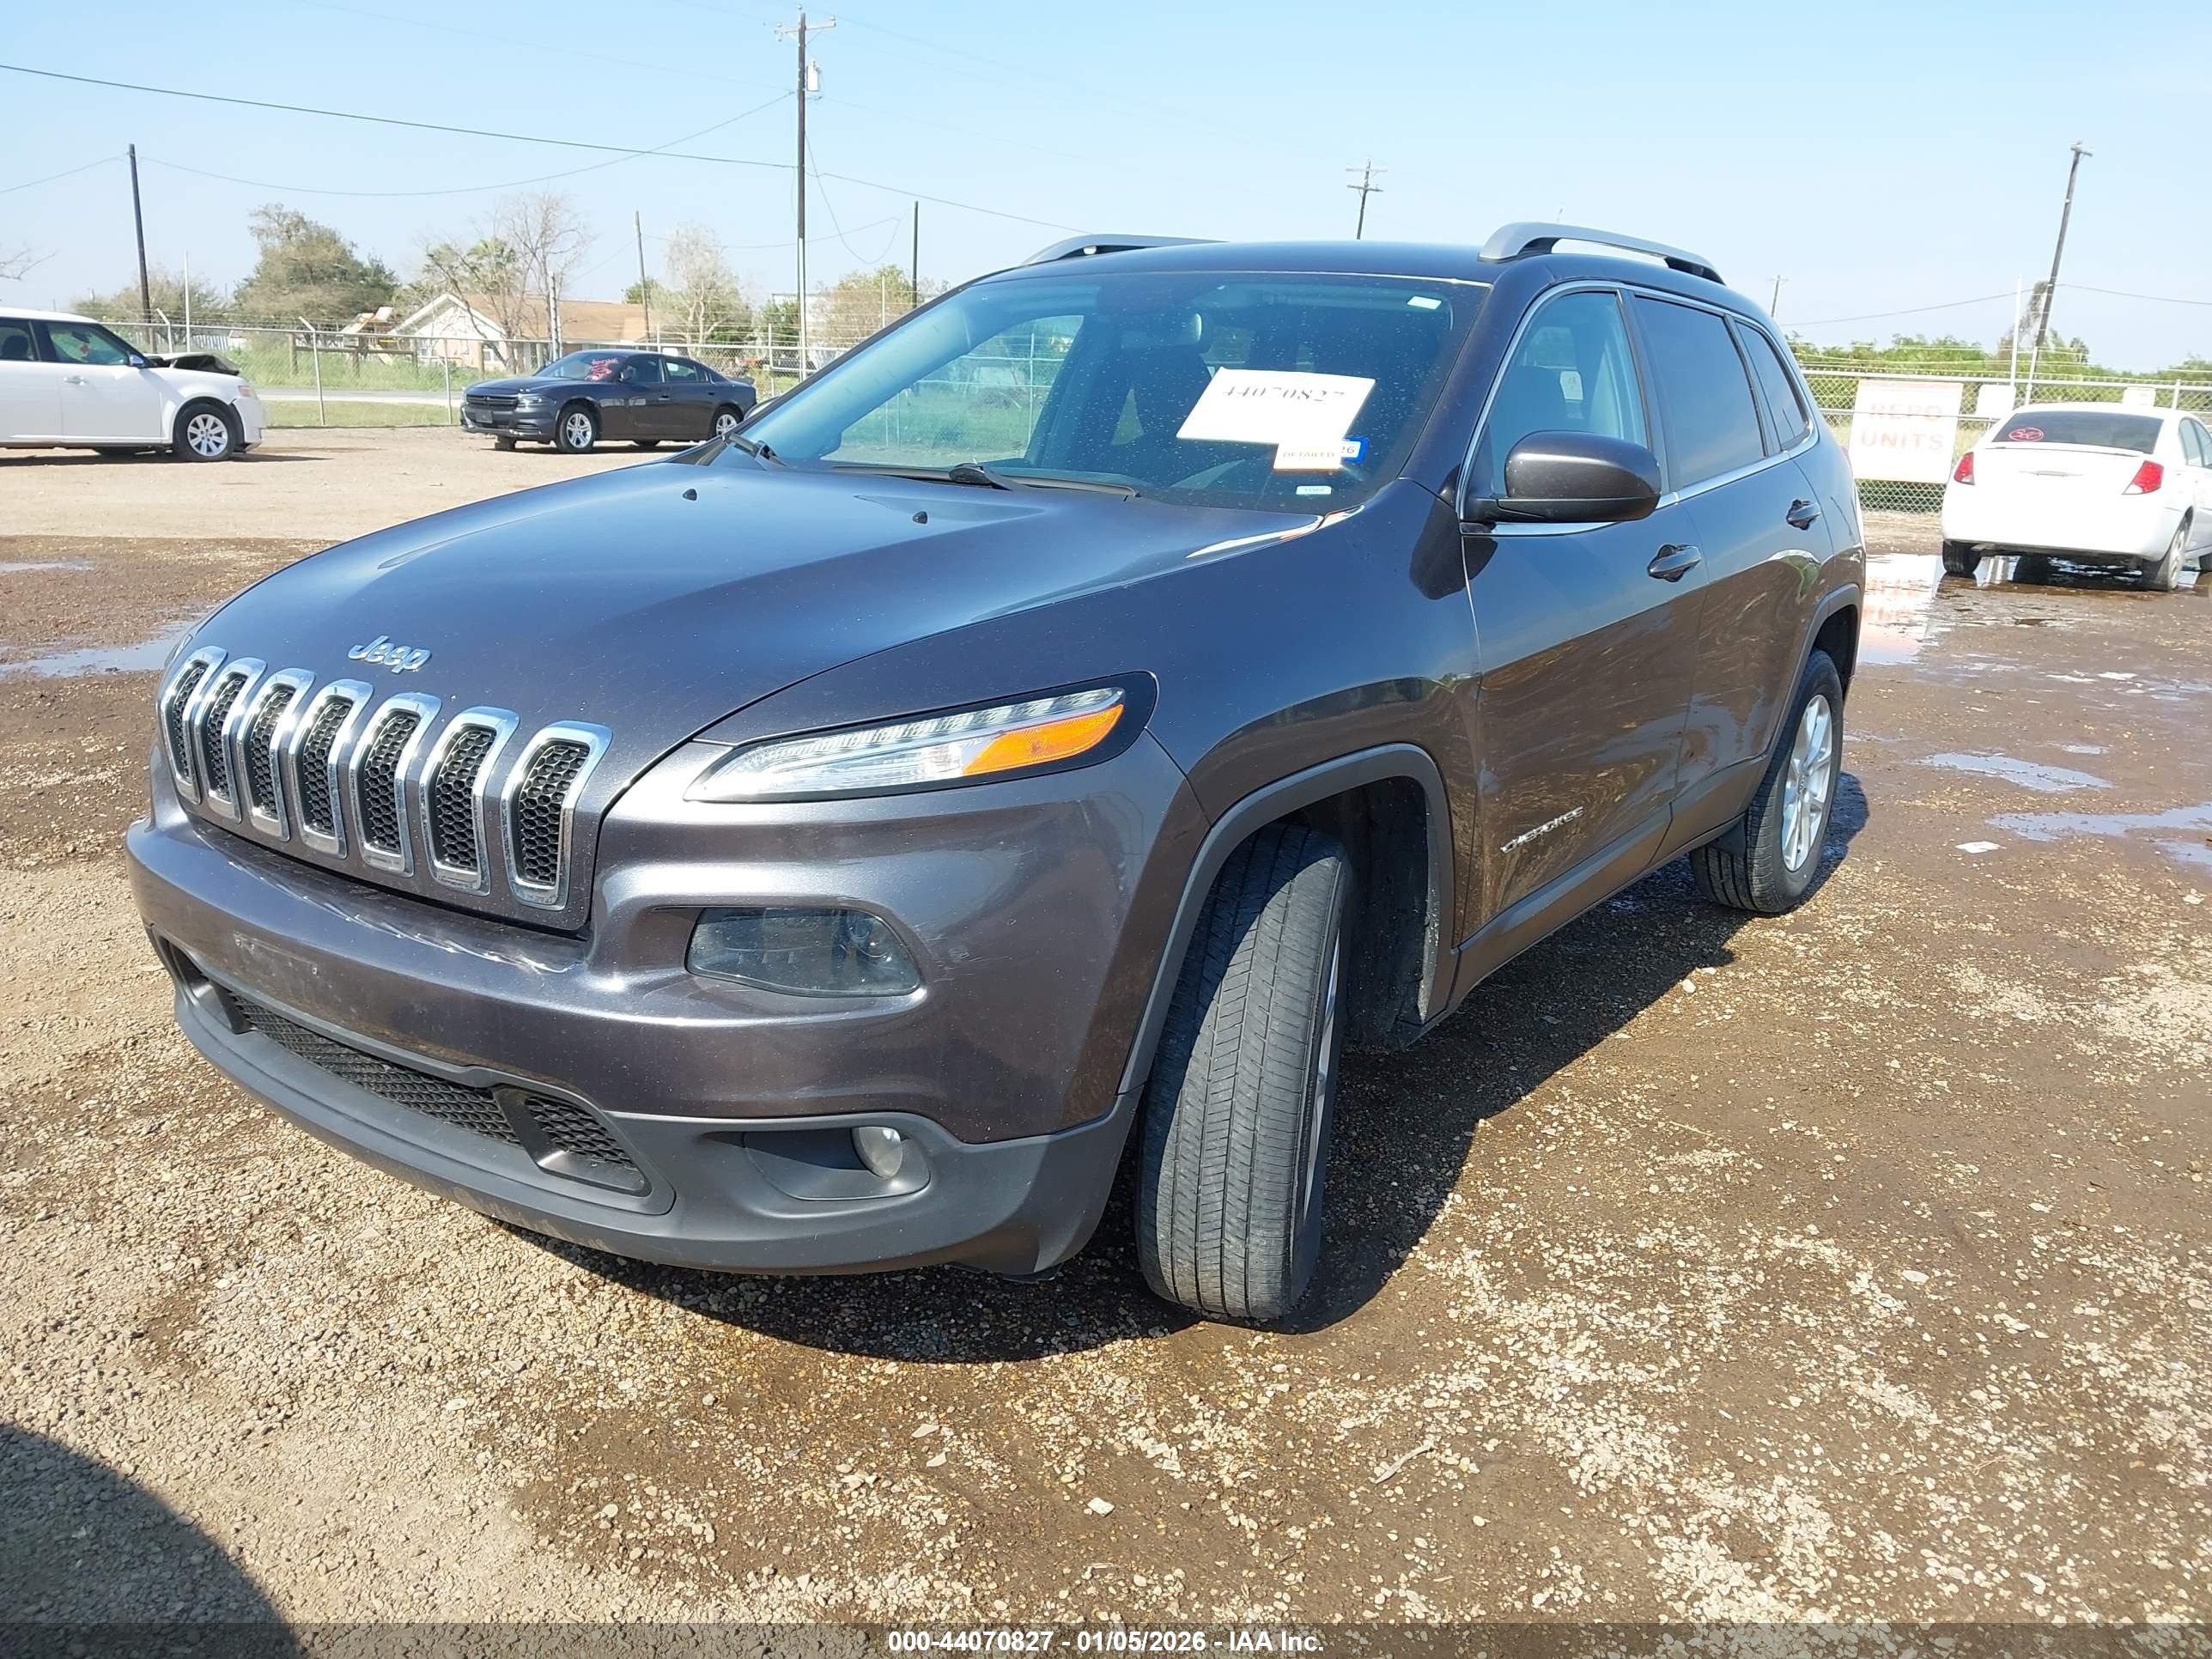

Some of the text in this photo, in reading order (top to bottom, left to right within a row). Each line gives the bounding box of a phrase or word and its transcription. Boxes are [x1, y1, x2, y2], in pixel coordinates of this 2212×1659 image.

[1223, 385, 1346, 402] 44070827
[1861, 430, 1944, 452] UNITS
[348, 635, 431, 674] Jeep
